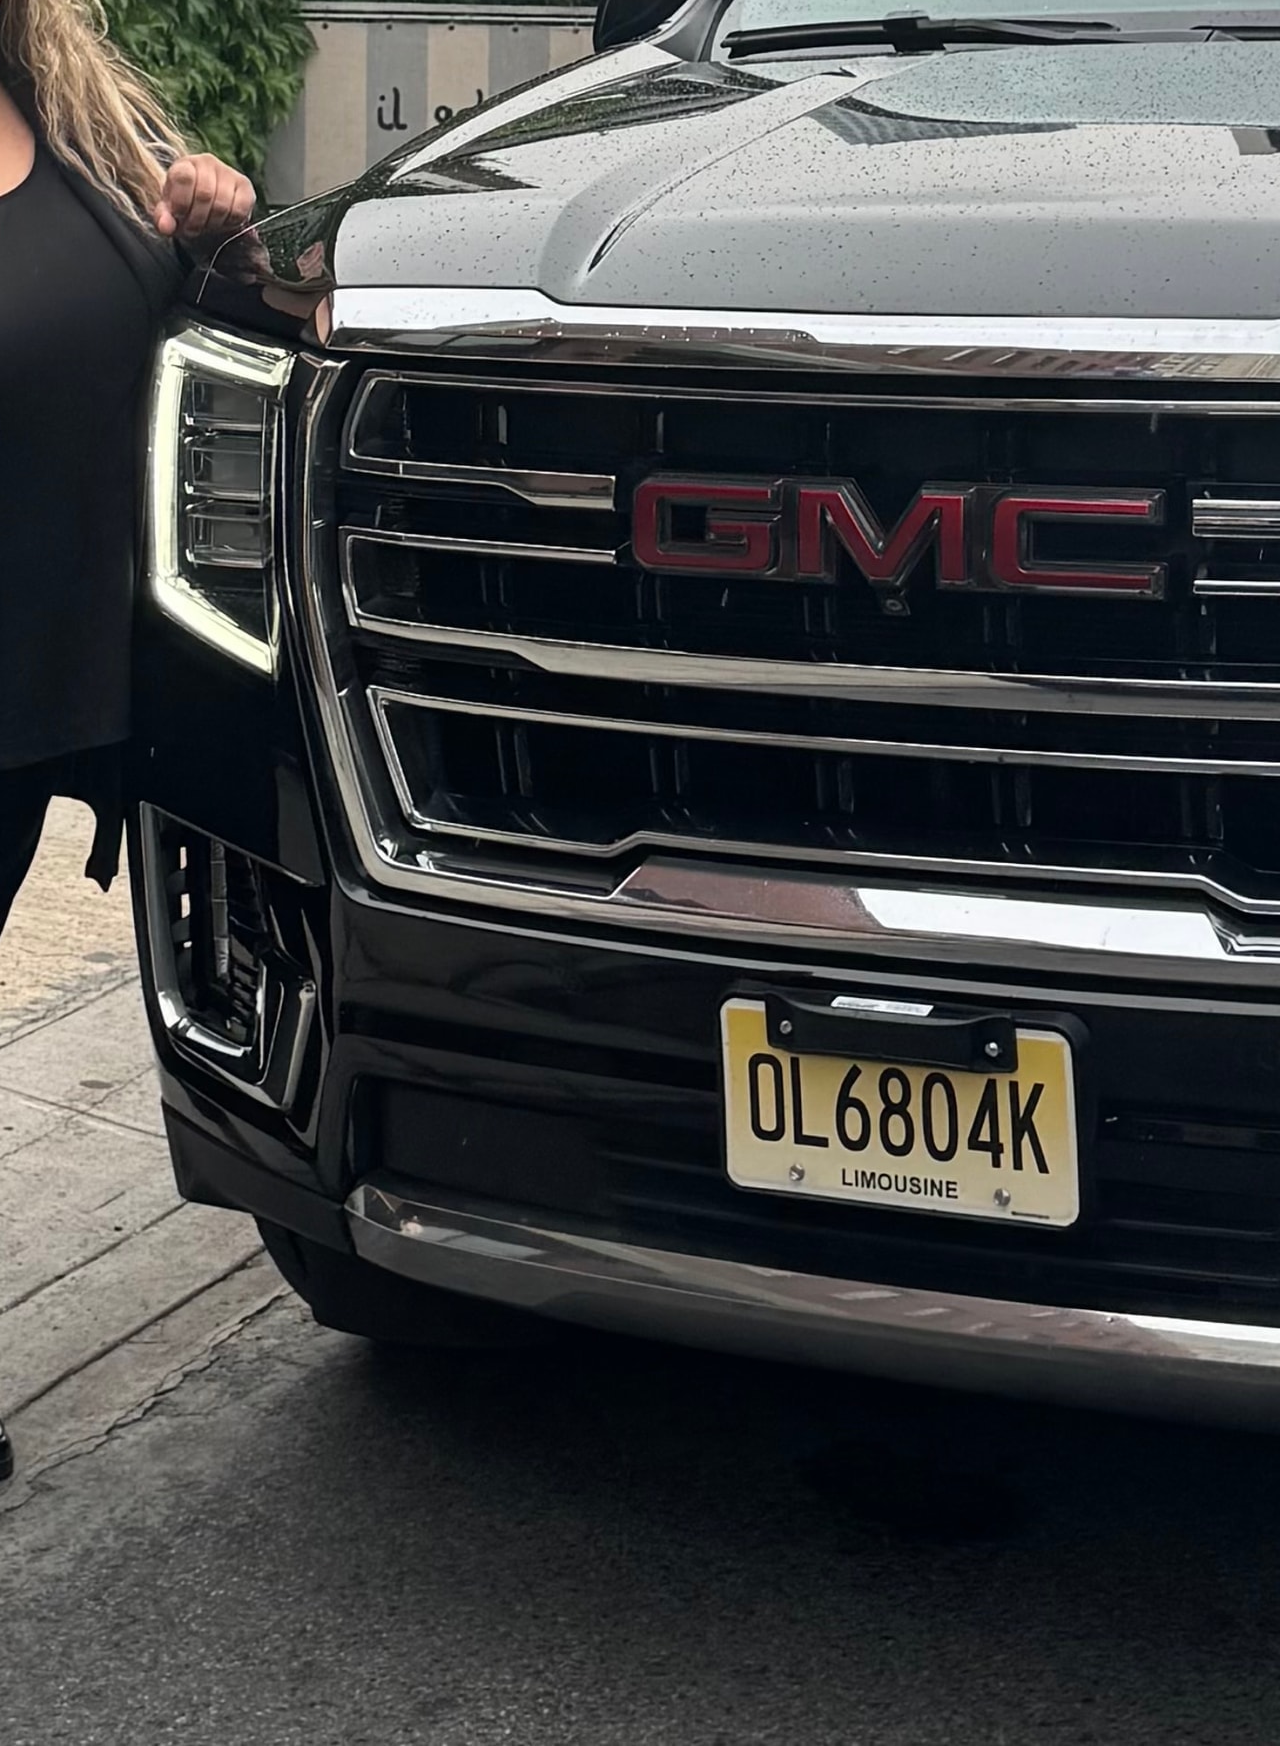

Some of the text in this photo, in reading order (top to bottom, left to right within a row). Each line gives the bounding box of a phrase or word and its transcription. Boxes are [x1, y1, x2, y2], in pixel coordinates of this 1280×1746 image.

[376, 86, 408, 130] il
[632, 472, 1167, 599] GMC
[747, 1052, 1050, 1175] OL6804K
[841, 1167, 959, 1200] LIMOUSINE
